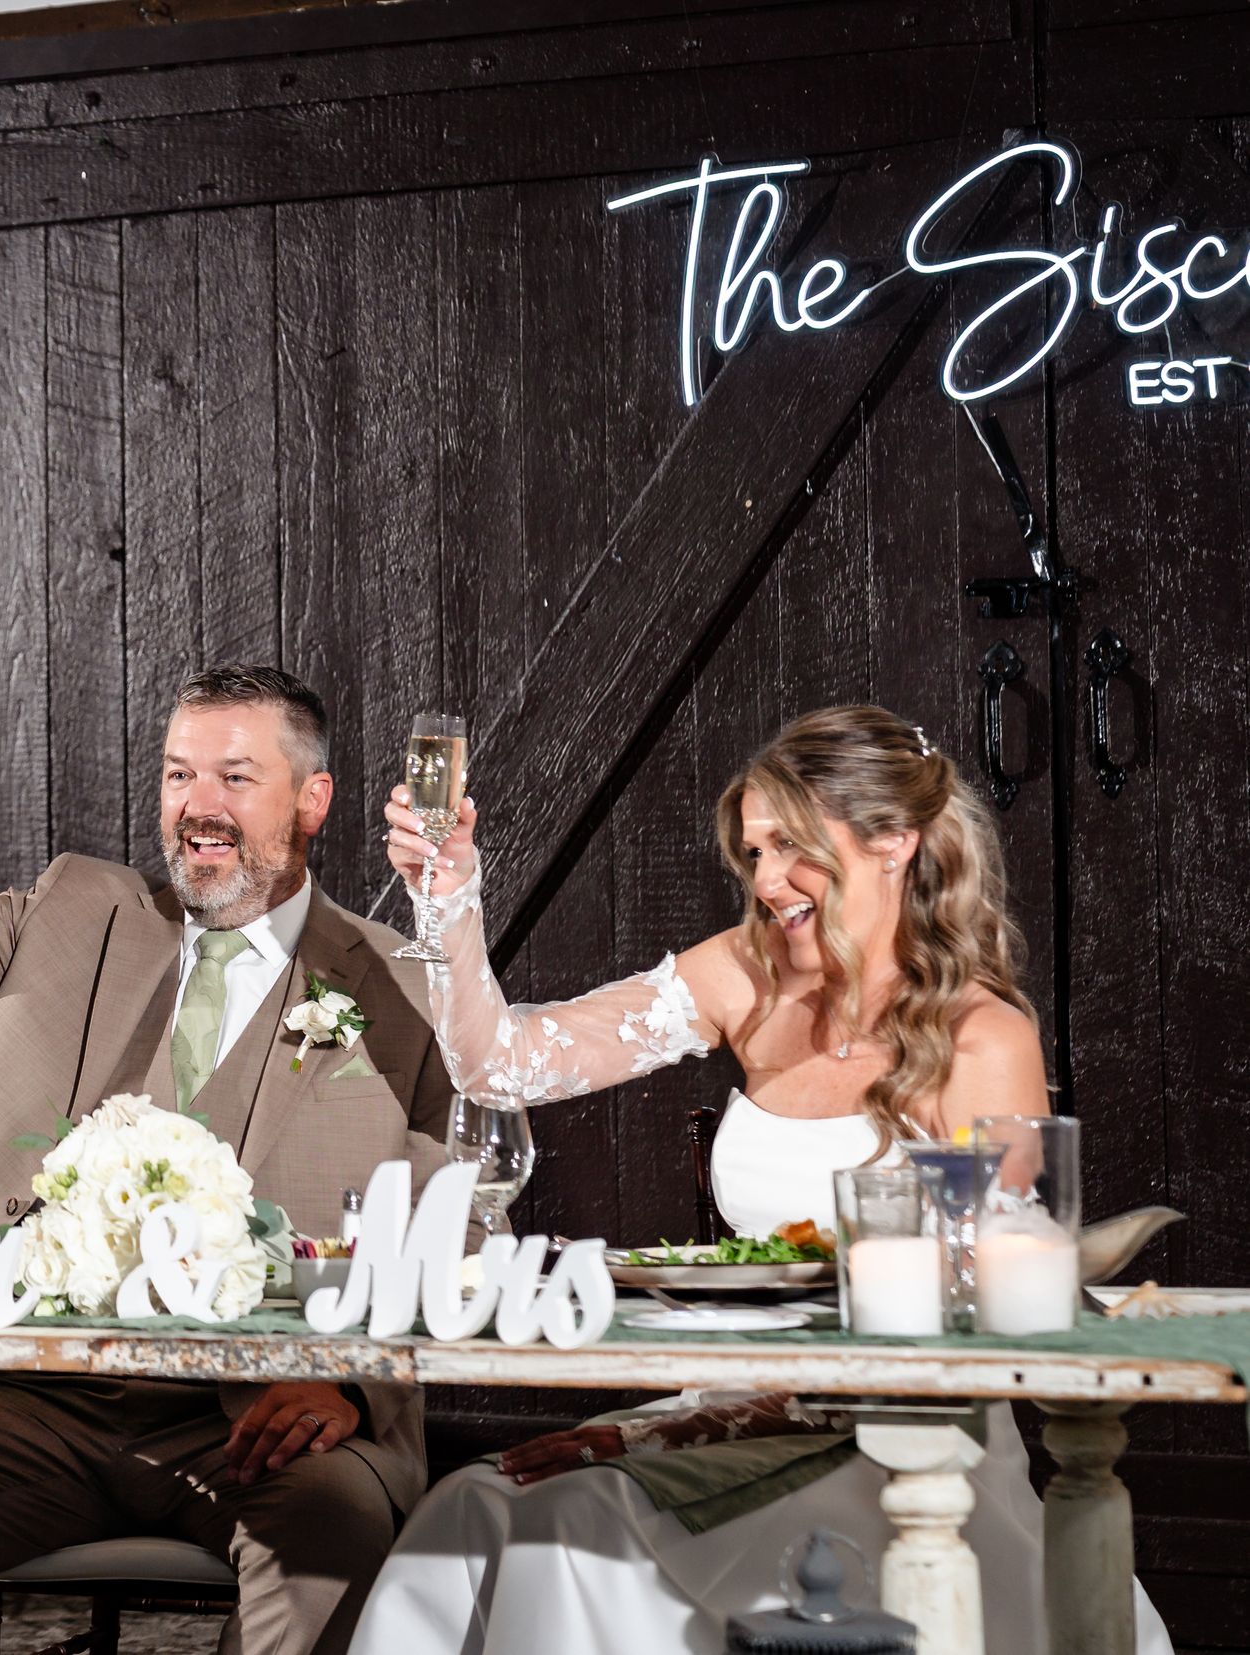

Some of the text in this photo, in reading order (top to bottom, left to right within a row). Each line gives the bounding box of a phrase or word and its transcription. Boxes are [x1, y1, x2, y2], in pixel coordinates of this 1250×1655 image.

[608, 142, 1250, 406] The Sisc
[1129, 357, 1233, 405] EST
[116, 1201, 232, 1324] &
[305, 1160, 616, 1350] Mrs
